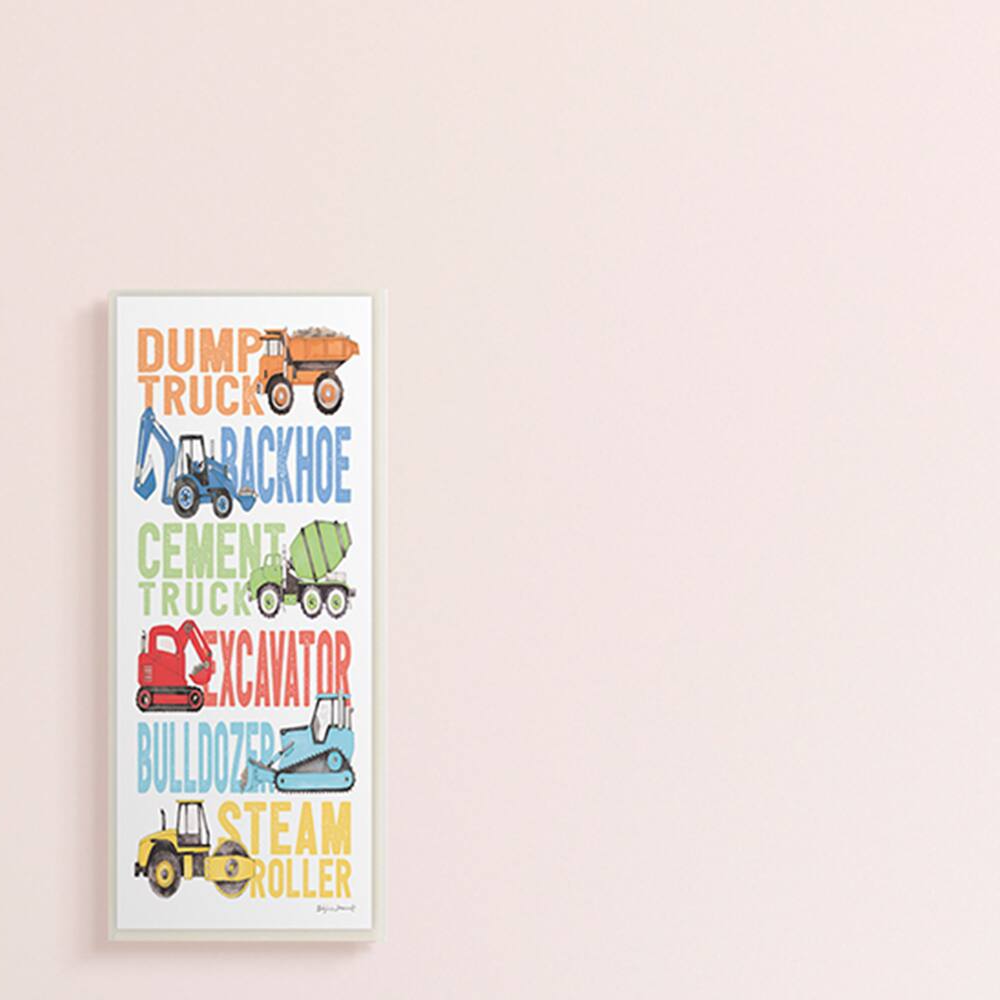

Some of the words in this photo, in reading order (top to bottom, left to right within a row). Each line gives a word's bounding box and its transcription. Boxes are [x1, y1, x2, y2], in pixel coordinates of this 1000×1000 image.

[137, 328, 263, 373] DUMP
[137, 375, 265, 416] TRUCK
[221, 425, 352, 503] BACKHOE
[137, 522, 286, 579] CEMENT
[137, 581, 252, 616] TRUCK
[203, 629, 352, 708] EXCAVATOR
[137, 721, 275, 794] BULLDOZER
[217, 801, 352, 856] STEAM
[250, 858, 352, 898] ROLLER
